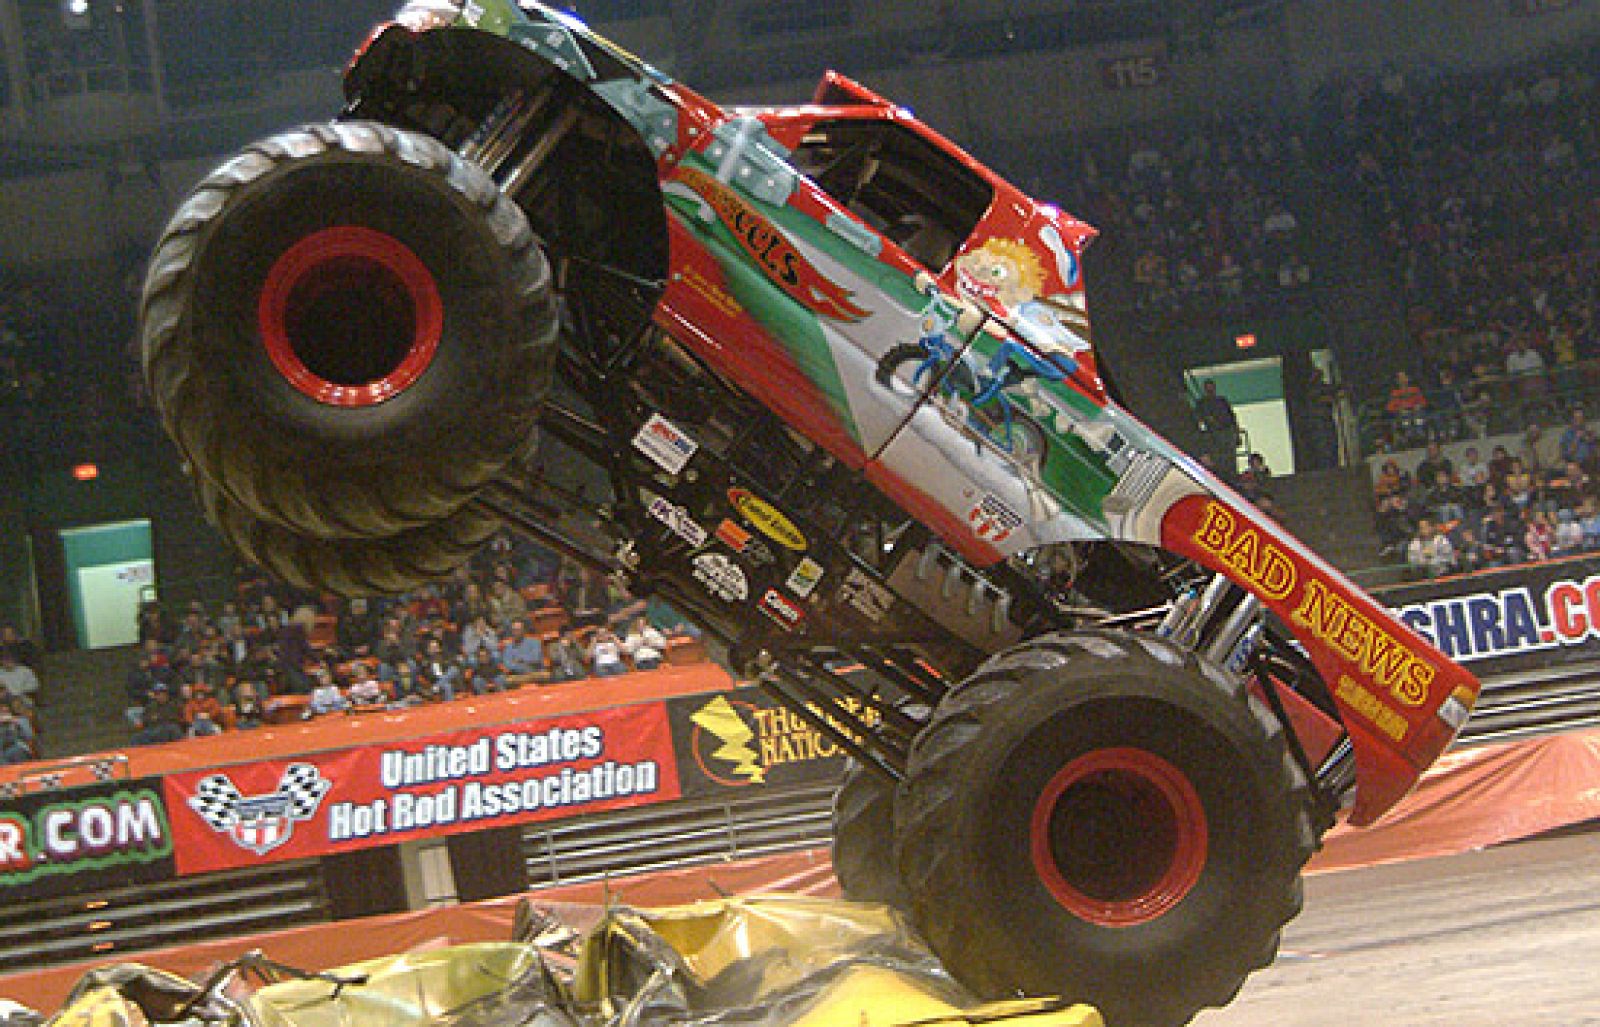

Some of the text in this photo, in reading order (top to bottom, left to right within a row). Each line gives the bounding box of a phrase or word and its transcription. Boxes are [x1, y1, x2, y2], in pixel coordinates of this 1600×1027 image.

[1194, 501, 1436, 706] BAD NEWS
[381, 726, 603, 788] United States
[328, 799, 389, 841] Hot
[391, 785, 459, 831] Rod
[461, 761, 659, 820] Association
